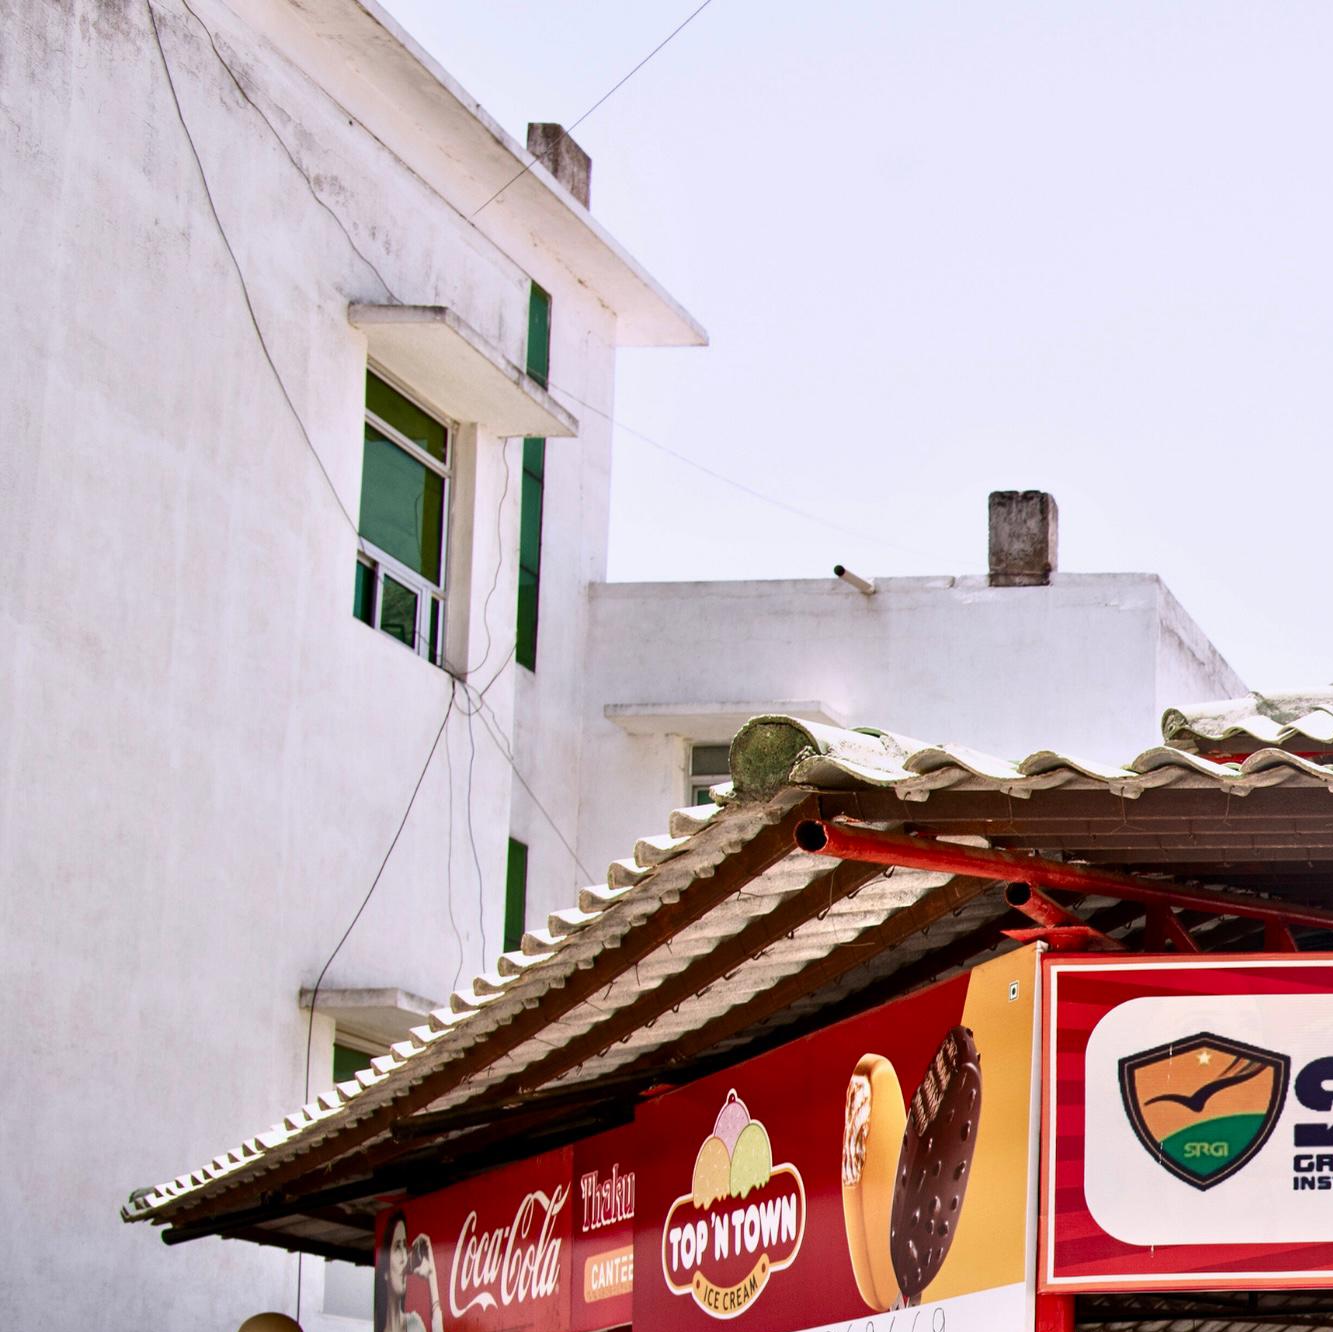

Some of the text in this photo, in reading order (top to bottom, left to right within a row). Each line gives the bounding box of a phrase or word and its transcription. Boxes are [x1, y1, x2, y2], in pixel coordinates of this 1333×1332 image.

[580, 1163, 635, 1233] Thaku
[669, 1220, 708, 1272] TOP
[732, 1193, 797, 1256] TOWN
[449, 1181, 571, 1319] Coca-Cola
[592, 1254, 634, 1291] CANTEE
[703, 1274, 759, 1311] ICE CREAM
